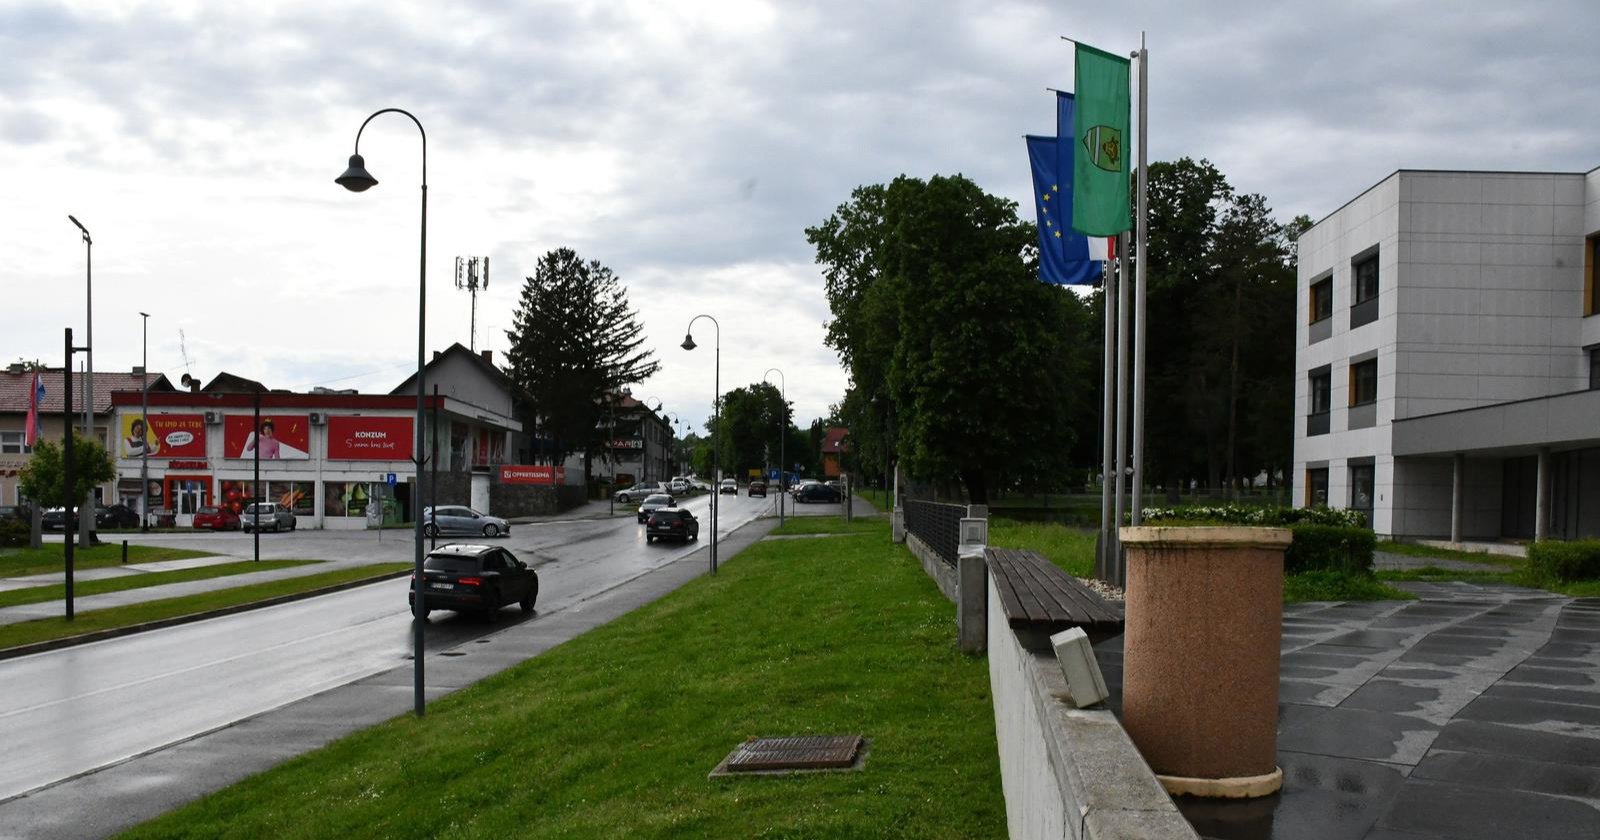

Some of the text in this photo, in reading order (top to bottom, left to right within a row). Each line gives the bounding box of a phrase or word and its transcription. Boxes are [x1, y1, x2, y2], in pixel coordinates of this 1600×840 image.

[355, 431, 386, 439] KONZUM
[511, 471, 550, 479] OFFERTISSIMA
[771, 470, 777, 478] P
